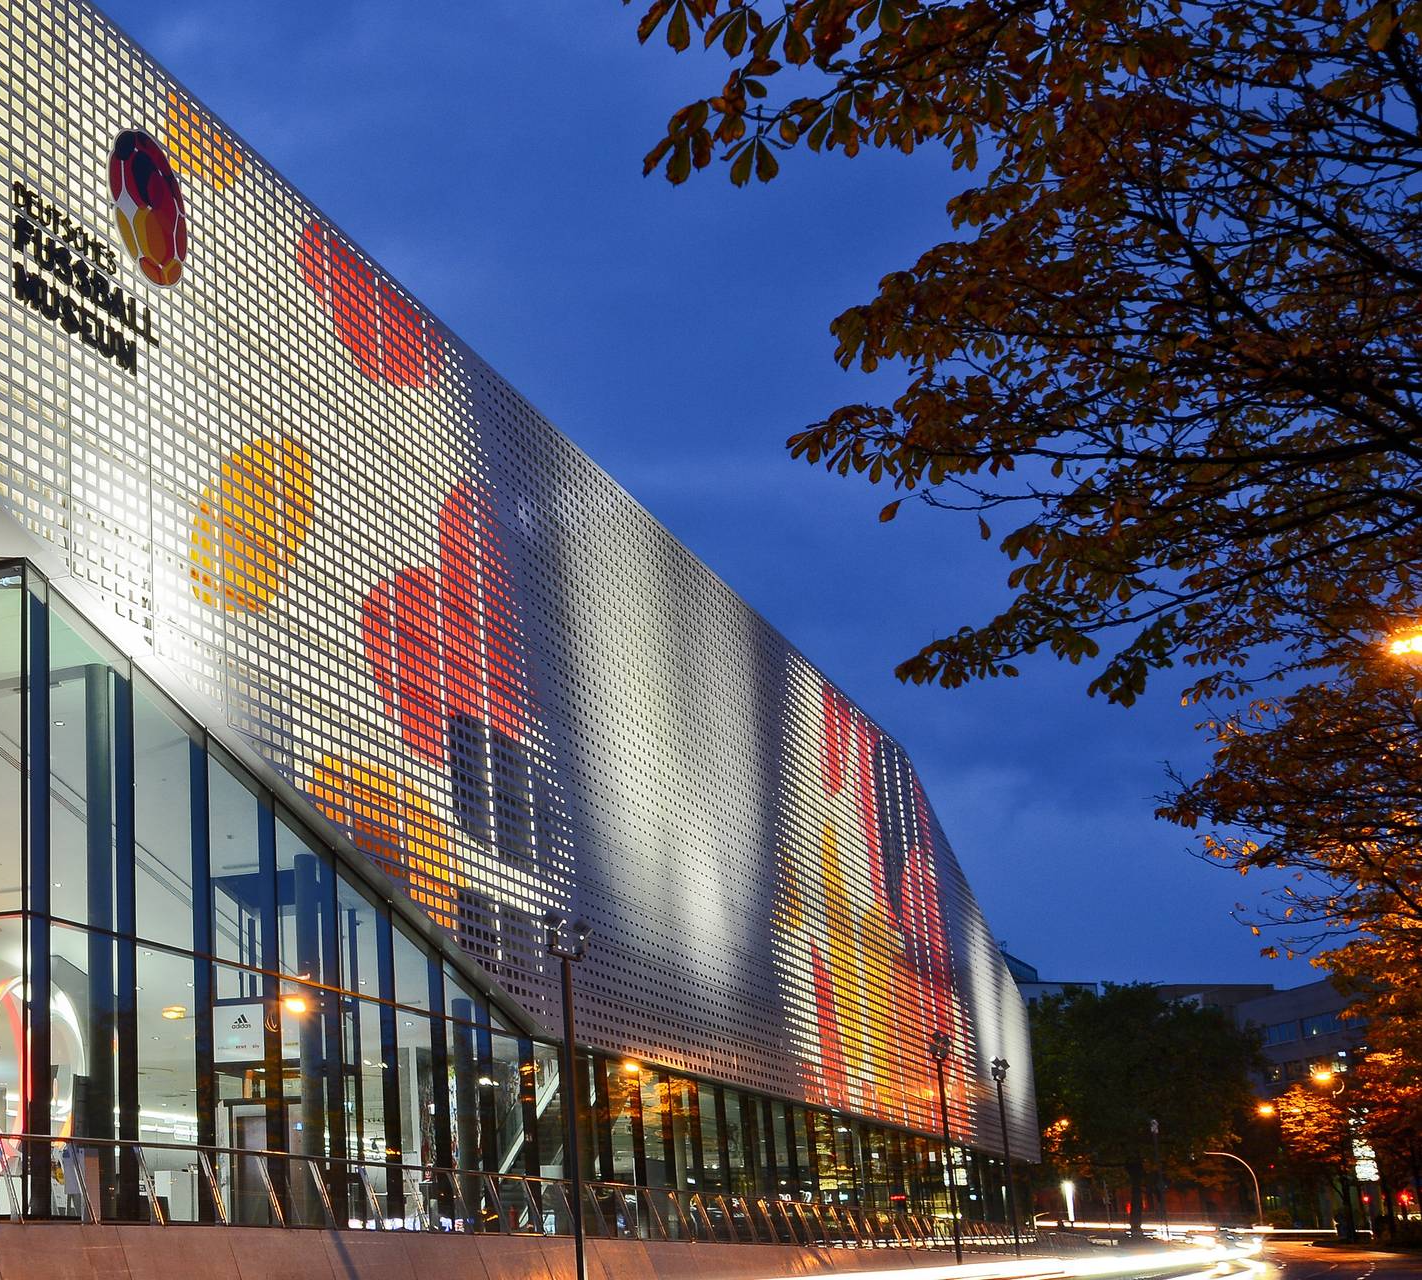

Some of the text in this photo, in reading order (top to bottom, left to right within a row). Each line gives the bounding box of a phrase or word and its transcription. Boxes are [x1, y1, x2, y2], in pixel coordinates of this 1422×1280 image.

[13, 181, 117, 275] DEUTSCHES
[13, 214, 160, 348] FUSSBALL
[13, 262, 137, 376] MUSEUM
